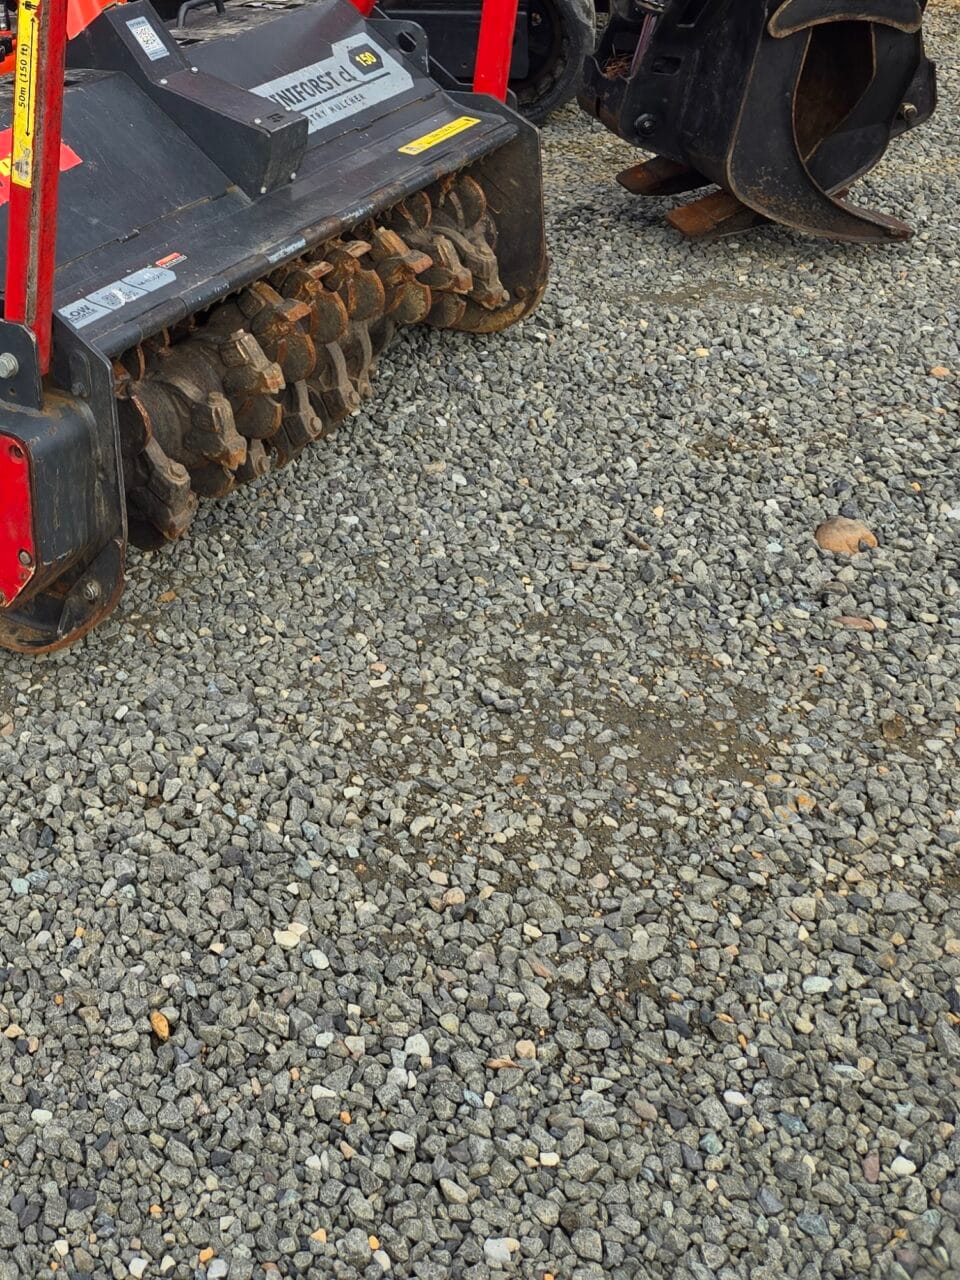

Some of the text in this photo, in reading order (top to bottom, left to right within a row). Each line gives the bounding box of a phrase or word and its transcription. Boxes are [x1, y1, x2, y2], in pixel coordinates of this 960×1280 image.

[18, 43, 31, 109] 50m (150 ft)
[355, 52, 377, 66] 150
